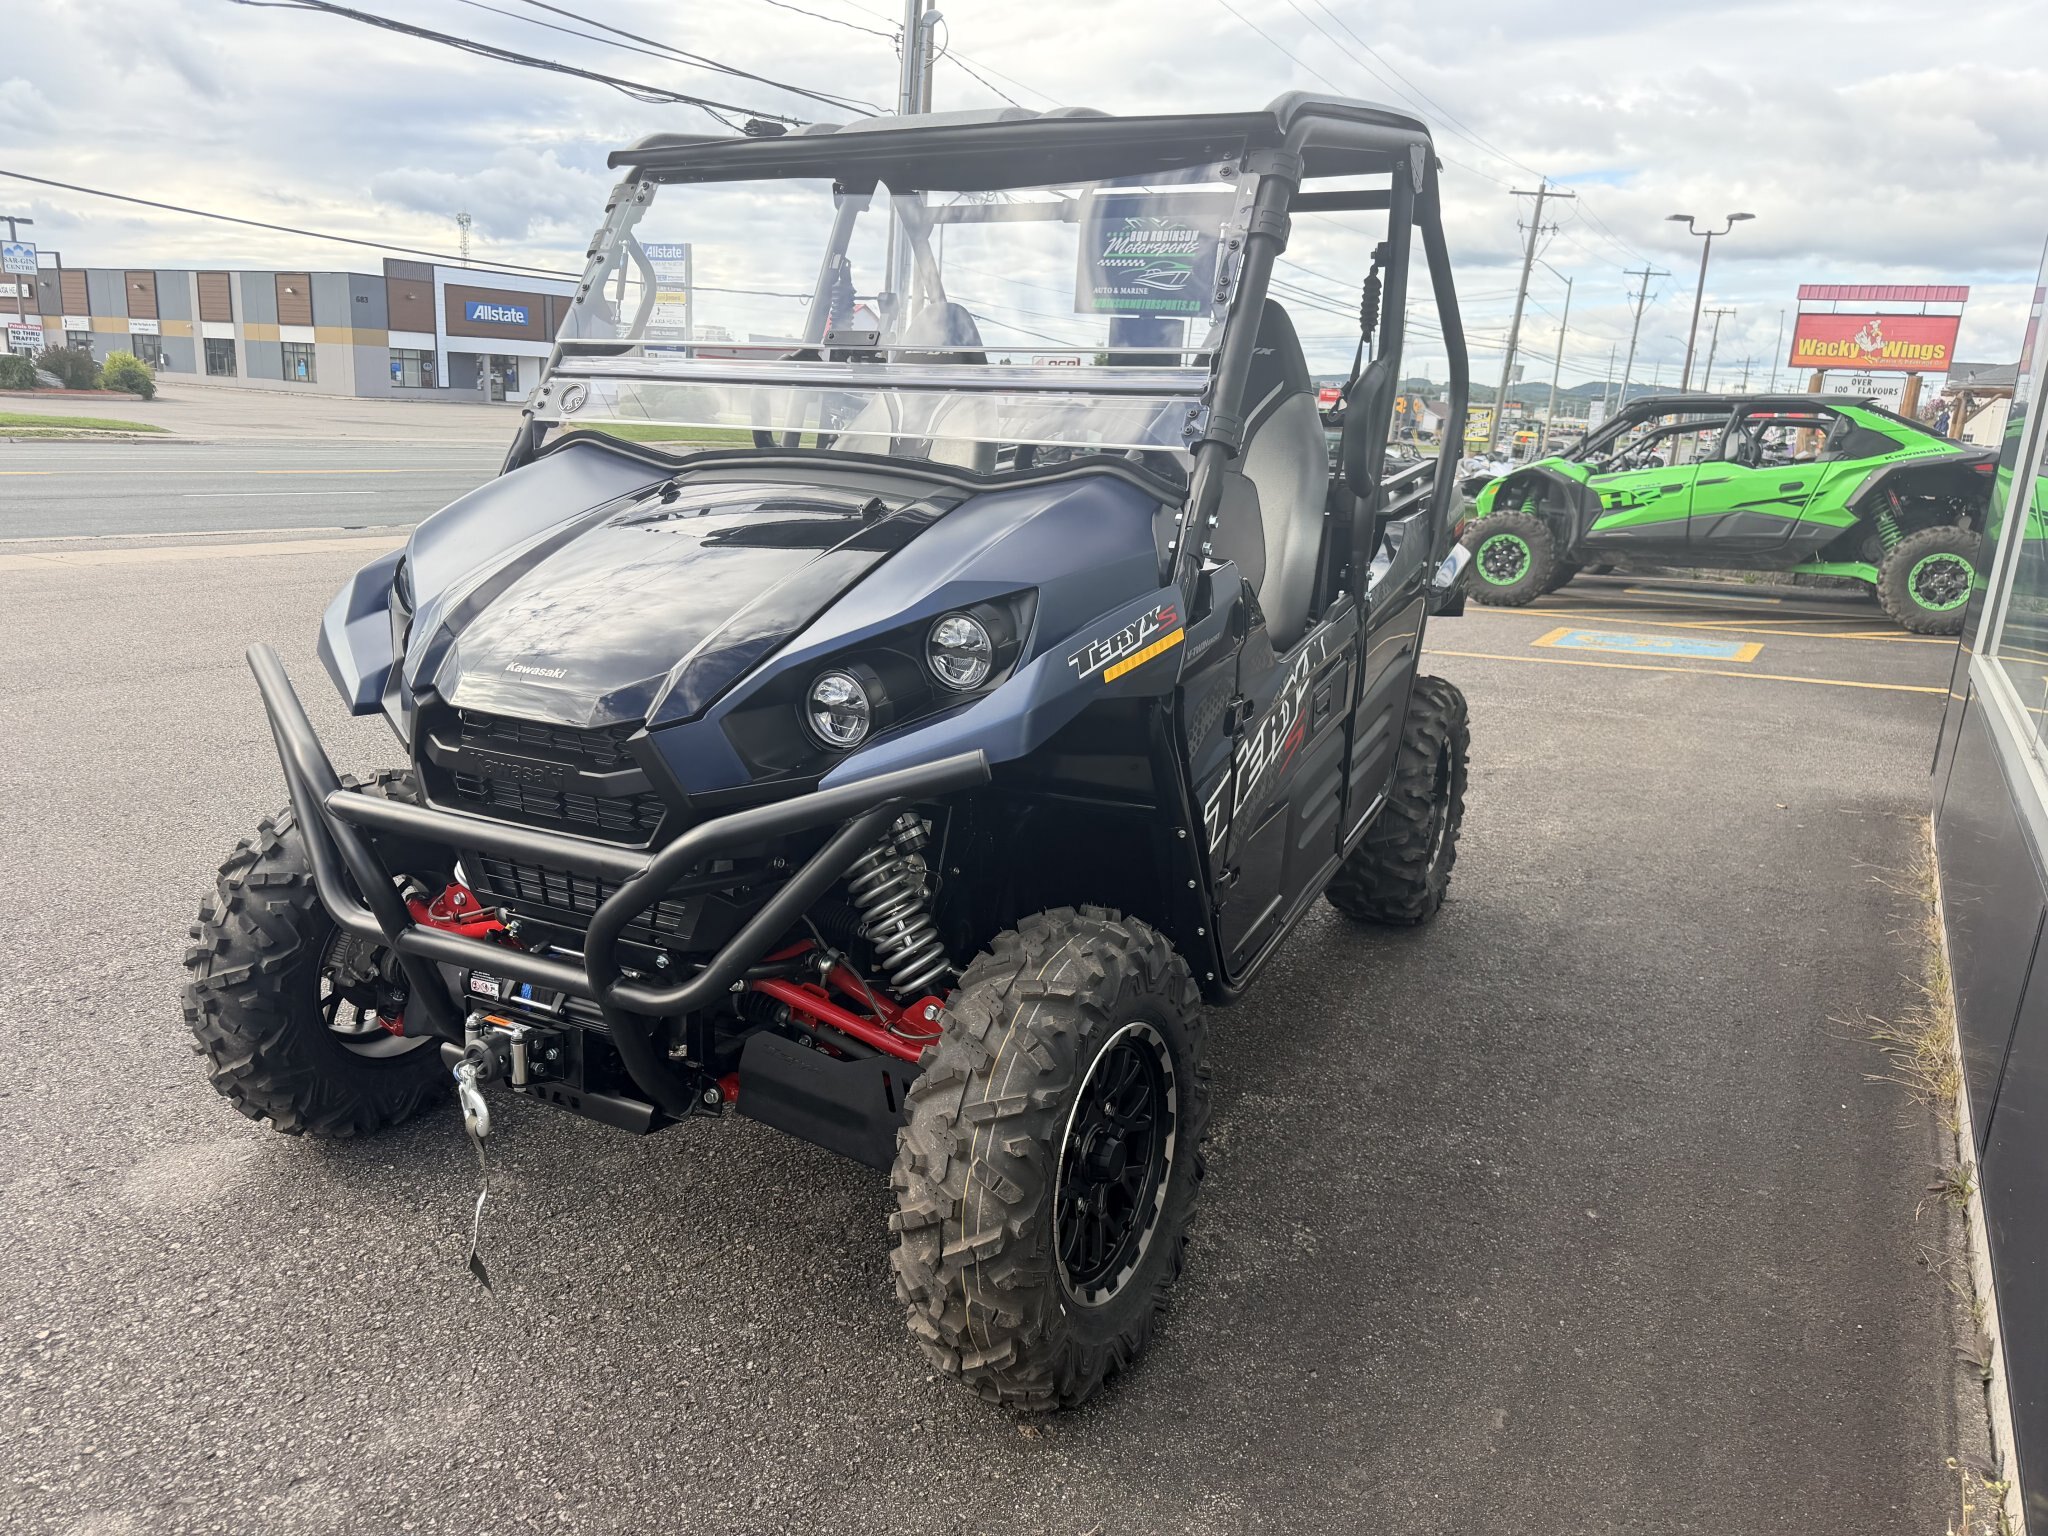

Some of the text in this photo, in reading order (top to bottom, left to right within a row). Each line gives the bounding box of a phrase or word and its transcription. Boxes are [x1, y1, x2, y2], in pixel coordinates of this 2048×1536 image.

[1130, 230, 1199, 243] BUD ROBINSON
[646, 245, 682, 258] Allstate
[1103, 237, 1200, 257] Motorsports
[4, 257, 35, 265] SAR-GIN
[1120, 287, 1149, 295] MARINE
[472, 304, 525, 323] Allstate
[1799, 339, 1945, 359] Wacky Wings
[1851, 378, 1873, 387] OVER
[1834, 386, 1898, 396] 100 FLAVOURS
[1885, 447, 1946, 461] Kawasaki
[505, 661, 568, 679] Kawasaki
